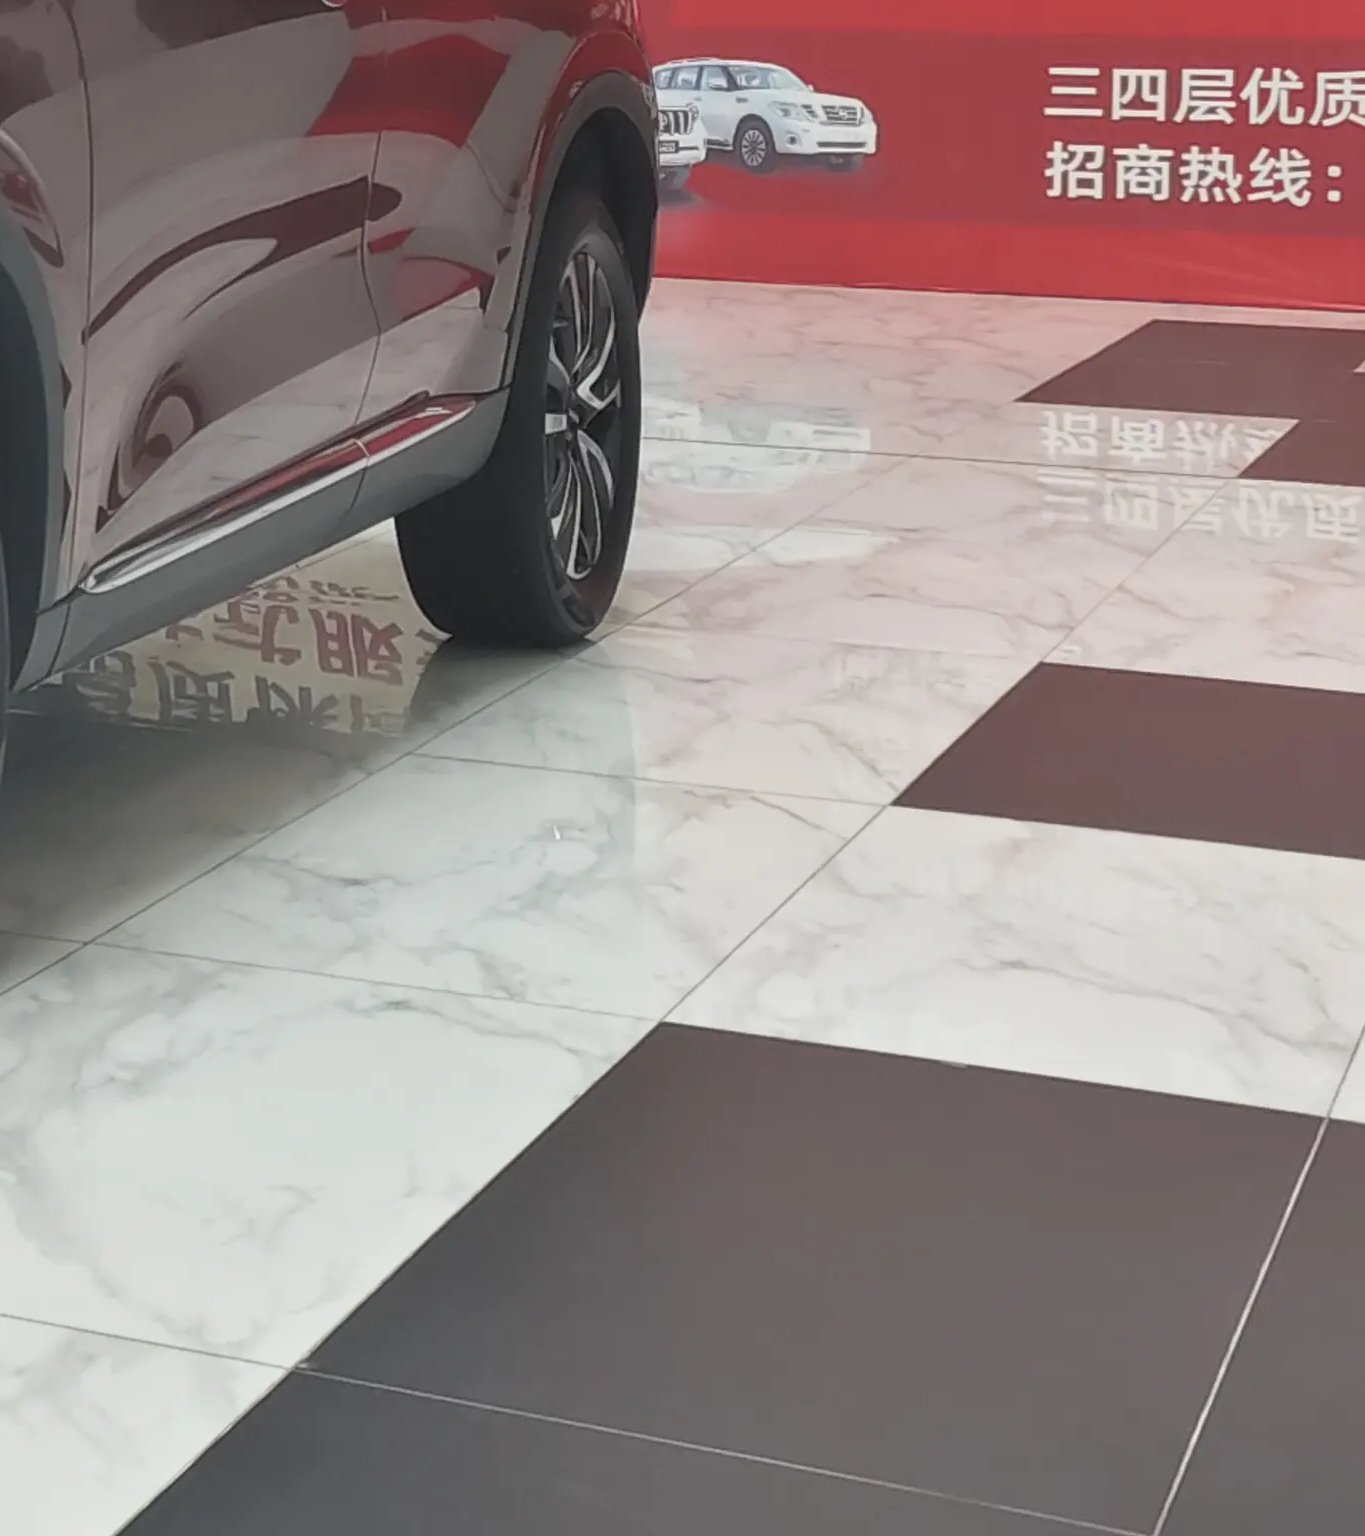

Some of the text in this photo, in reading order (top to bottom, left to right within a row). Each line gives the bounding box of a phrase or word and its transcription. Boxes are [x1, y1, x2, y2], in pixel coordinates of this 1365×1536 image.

[1042, 66, 1365, 128] 三四层优质
[1043, 140, 1344, 208] 招商热线：
